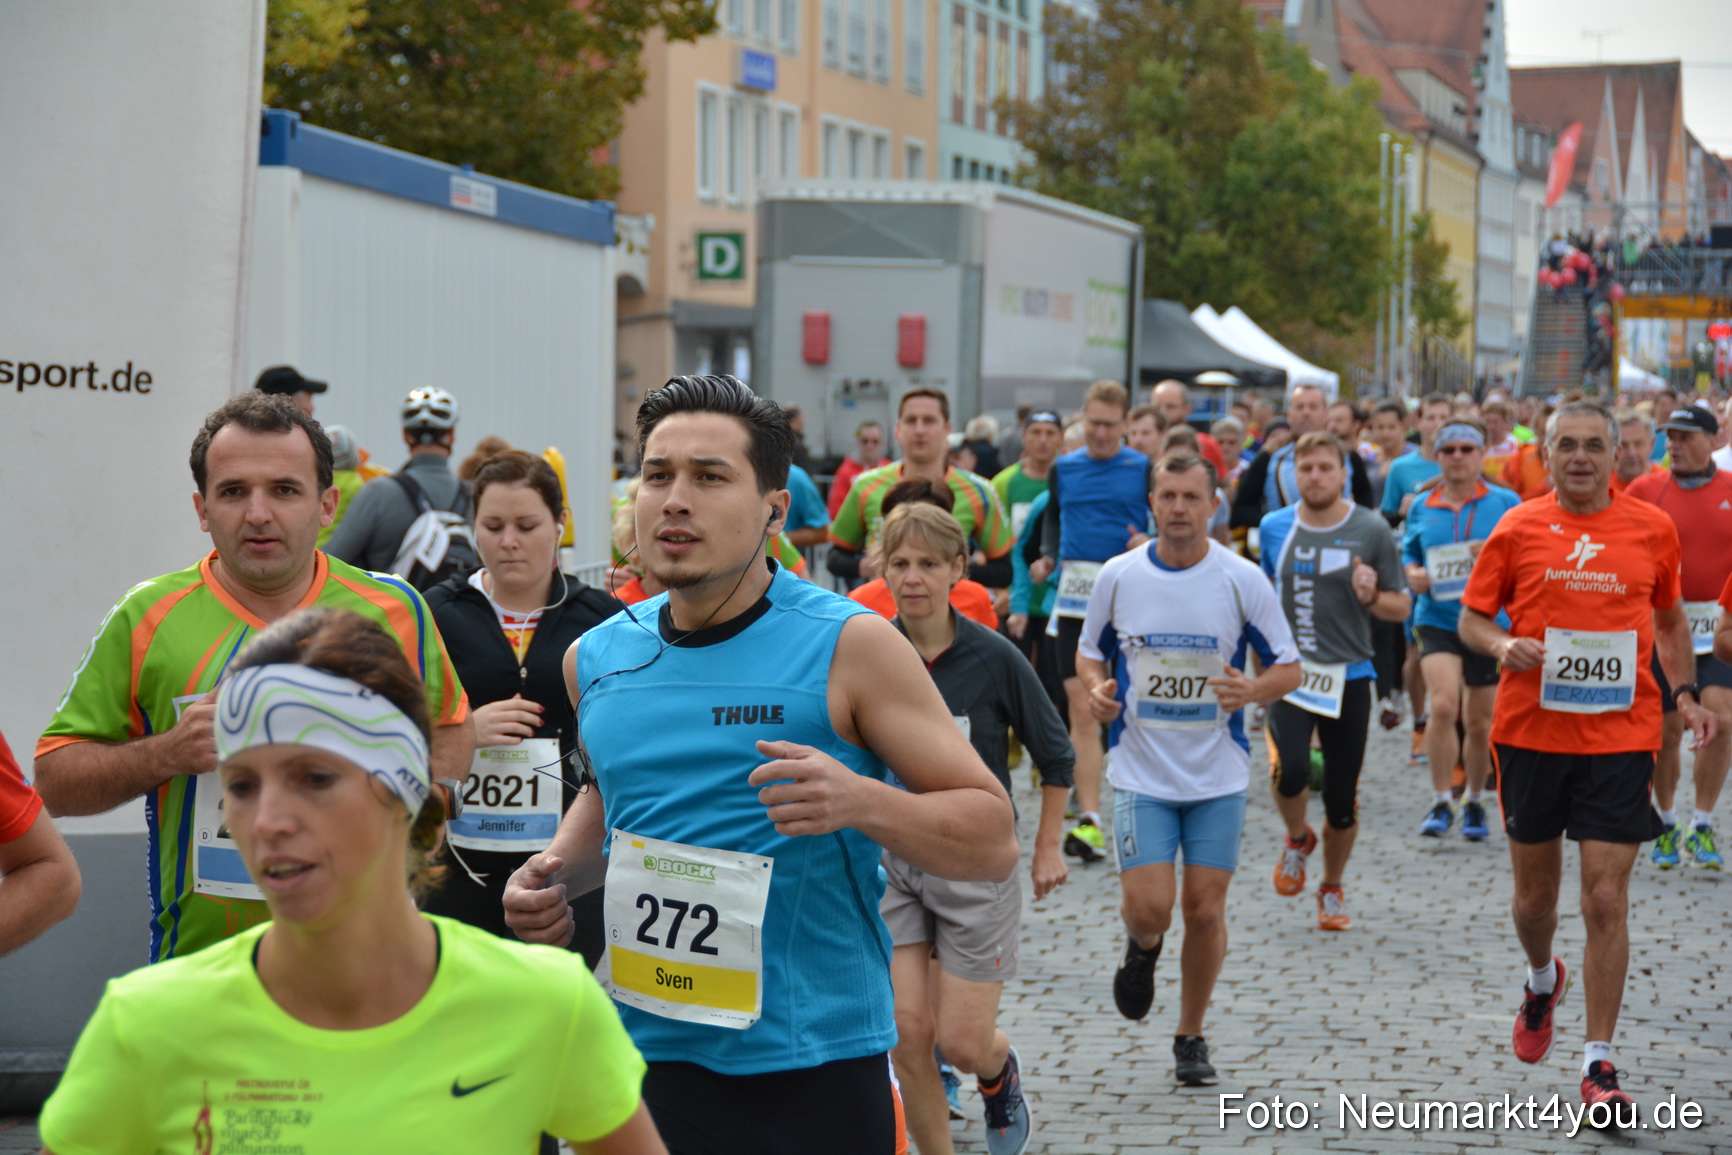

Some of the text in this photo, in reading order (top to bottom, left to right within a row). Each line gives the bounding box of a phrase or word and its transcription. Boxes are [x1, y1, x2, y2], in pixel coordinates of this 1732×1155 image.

[702, 237, 739, 276] D
[1544, 567, 1617, 582] funrunners
[1565, 580, 1627, 595] neumarkt
[1556, 656, 1622, 681] 2949
[1147, 675, 1209, 699] 2307
[1553, 685, 1625, 701] ERNST
[712, 705, 784, 726] THULE
[490, 750, 529, 760] BOCK
[463, 773, 539, 807] 2621
[477, 819, 526, 832] Jennifer
[657, 858, 717, 880] BOCK
[636, 893, 719, 956] 272
[656, 967, 693, 991] Sven
